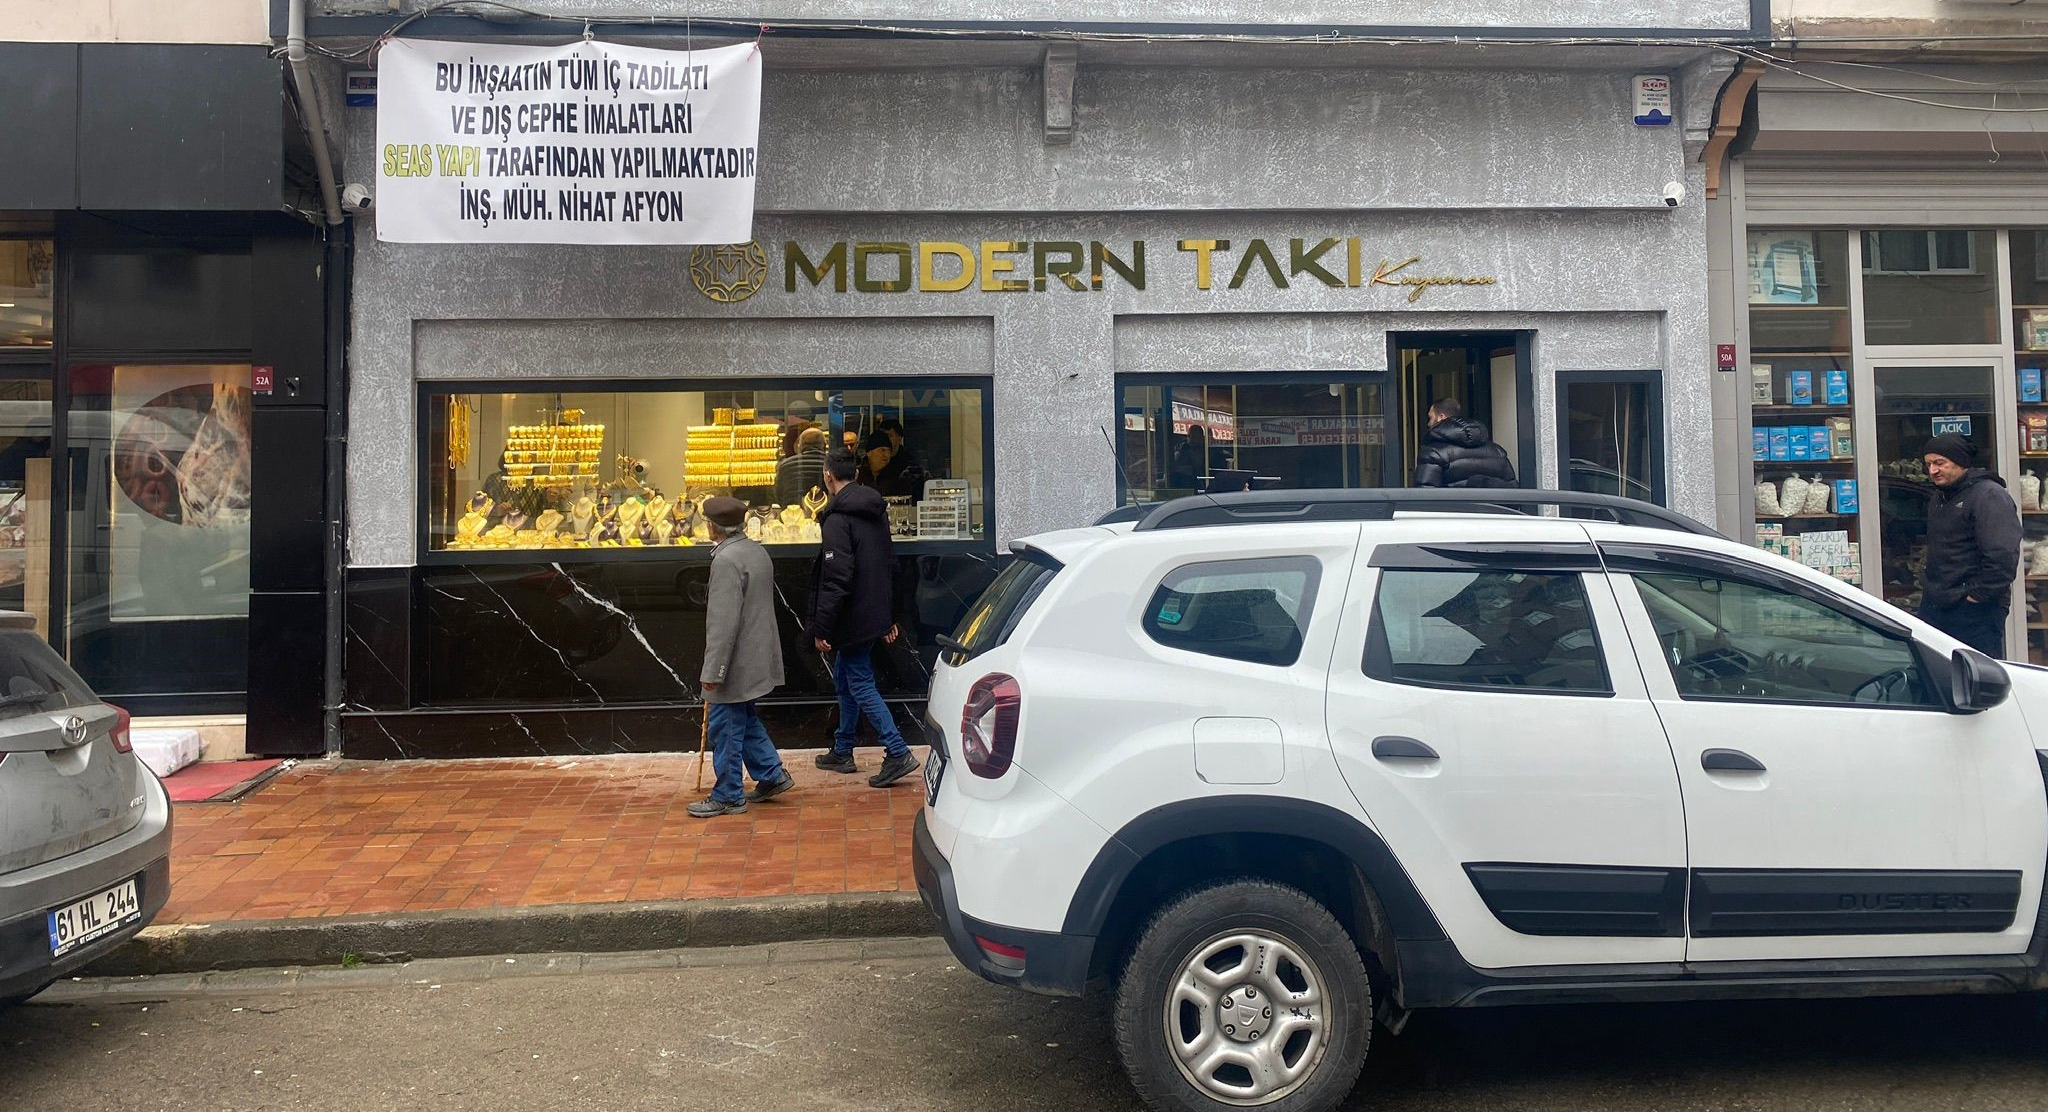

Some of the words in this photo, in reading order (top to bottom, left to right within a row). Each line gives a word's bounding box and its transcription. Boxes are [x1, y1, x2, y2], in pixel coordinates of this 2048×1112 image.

[435, 61, 461, 93] BU
[468, 56, 551, 100] İNŞAATIN
[558, 52, 598, 90] TÜM
[604, 52, 621, 98] İÇ
[627, 60, 708, 91] TADİLATI
[451, 106, 475, 135] VE
[482, 105, 512, 142] DIŞ
[517, 102, 577, 134] CEPHE
[584, 96, 693, 135] İMALATLARI
[383, 143, 432, 177] SEAS
[436, 142, 481, 177] YAPI
[487, 147, 604, 178] TARAFINDAN
[611, 147, 755, 179] YAPILMAKTADIR
[460, 181, 496, 228] İNŞ.
[503, 182, 552, 220] MÜH.
[559, 183, 616, 222] NİHAT
[622, 190, 684, 222] AFYON
[784, 241, 1145, 292] MODERN
[1176, 237, 1361, 290] TAKI
[256, 376, 270, 385] 52A
[57, 909, 75, 941] 61
[79, 900, 101, 932] HL
[107, 884, 135, 920] 244
[1838, 893, 1974, 910] DUSTER
